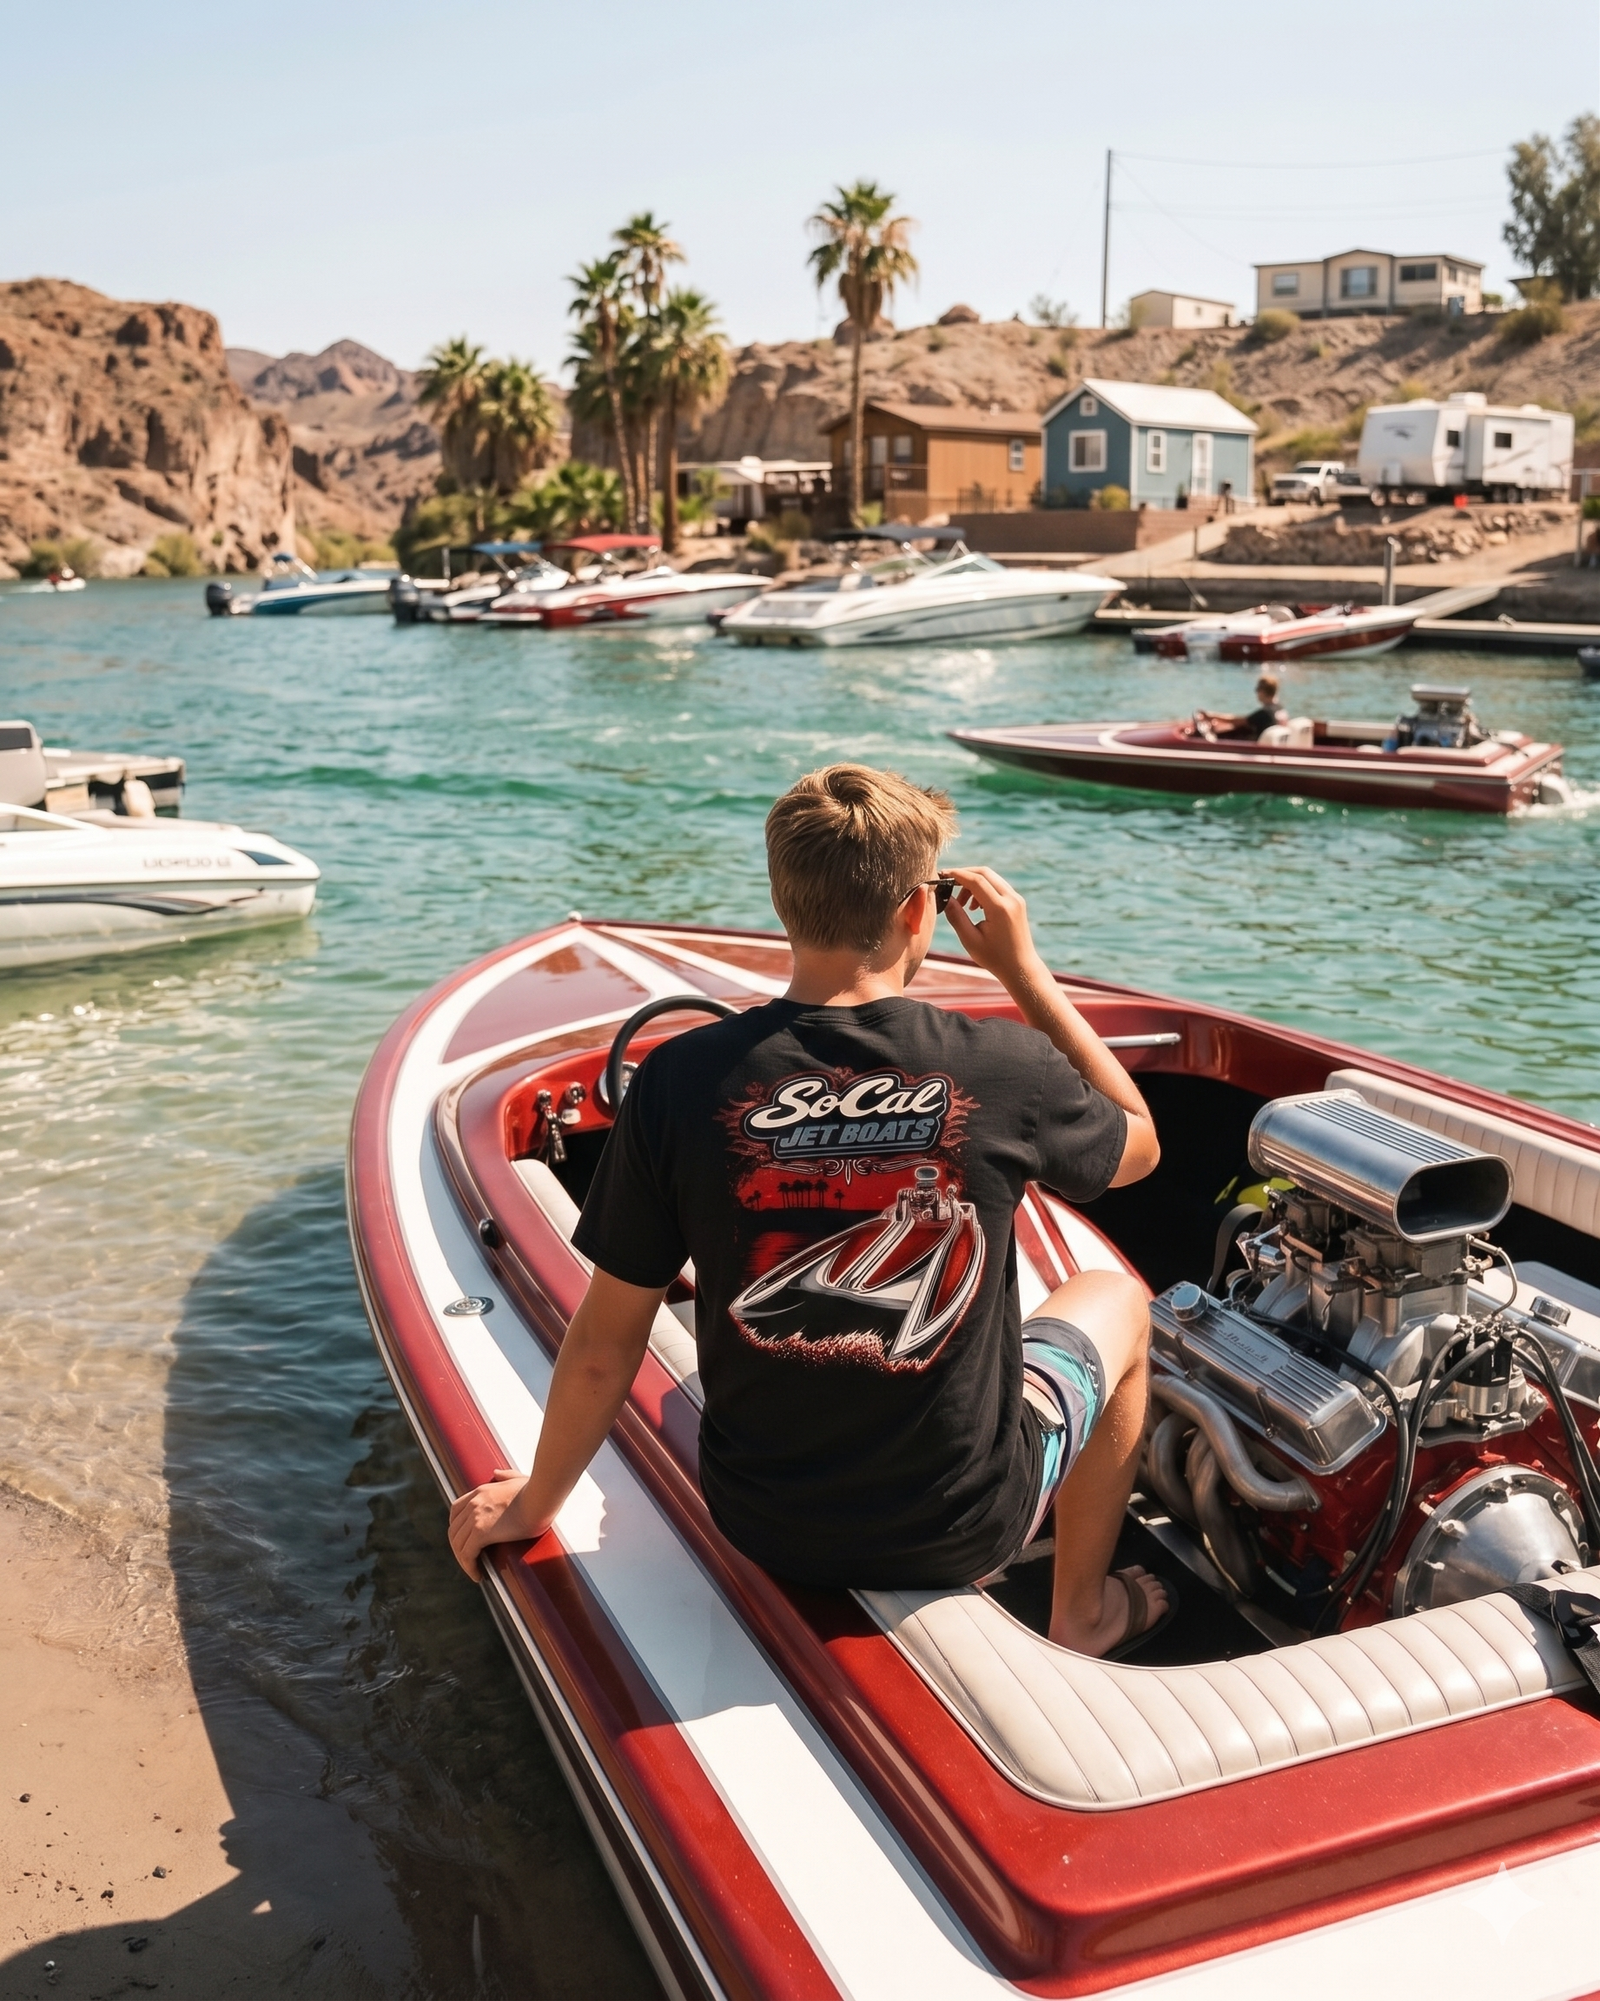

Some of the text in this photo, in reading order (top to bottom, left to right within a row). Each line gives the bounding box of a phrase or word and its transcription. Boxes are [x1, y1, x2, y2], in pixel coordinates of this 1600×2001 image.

[750, 1077, 943, 1128] SoCal
[780, 1118, 935, 1148] JET BOATS
